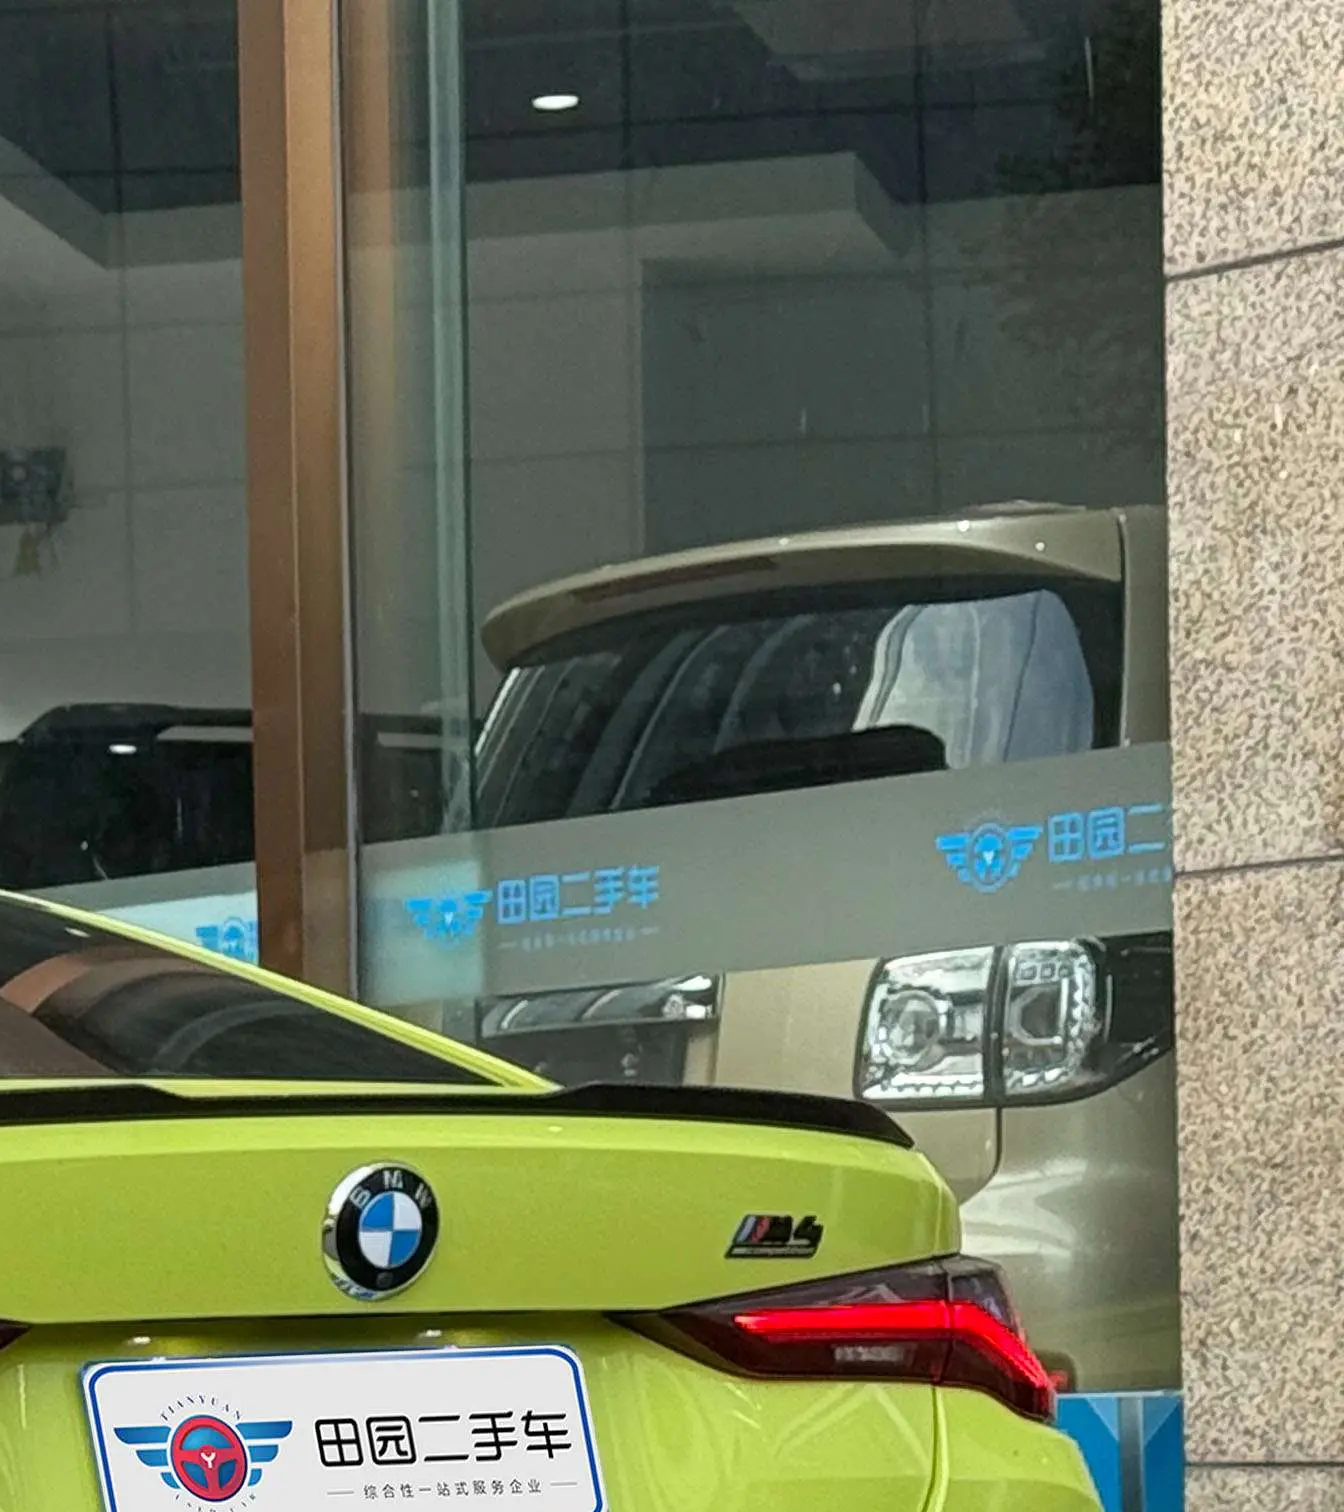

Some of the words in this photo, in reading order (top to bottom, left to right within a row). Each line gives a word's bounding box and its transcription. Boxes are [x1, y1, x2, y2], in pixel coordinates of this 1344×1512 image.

[496, 864, 660, 925] 田园二手车
[349, 1169, 433, 1210] BMW
[732, 1213, 825, 1248] M4
[314, 1409, 573, 1468] 田园二手车
[362, 1478, 543, 1501] 综合性一站式服务企业
